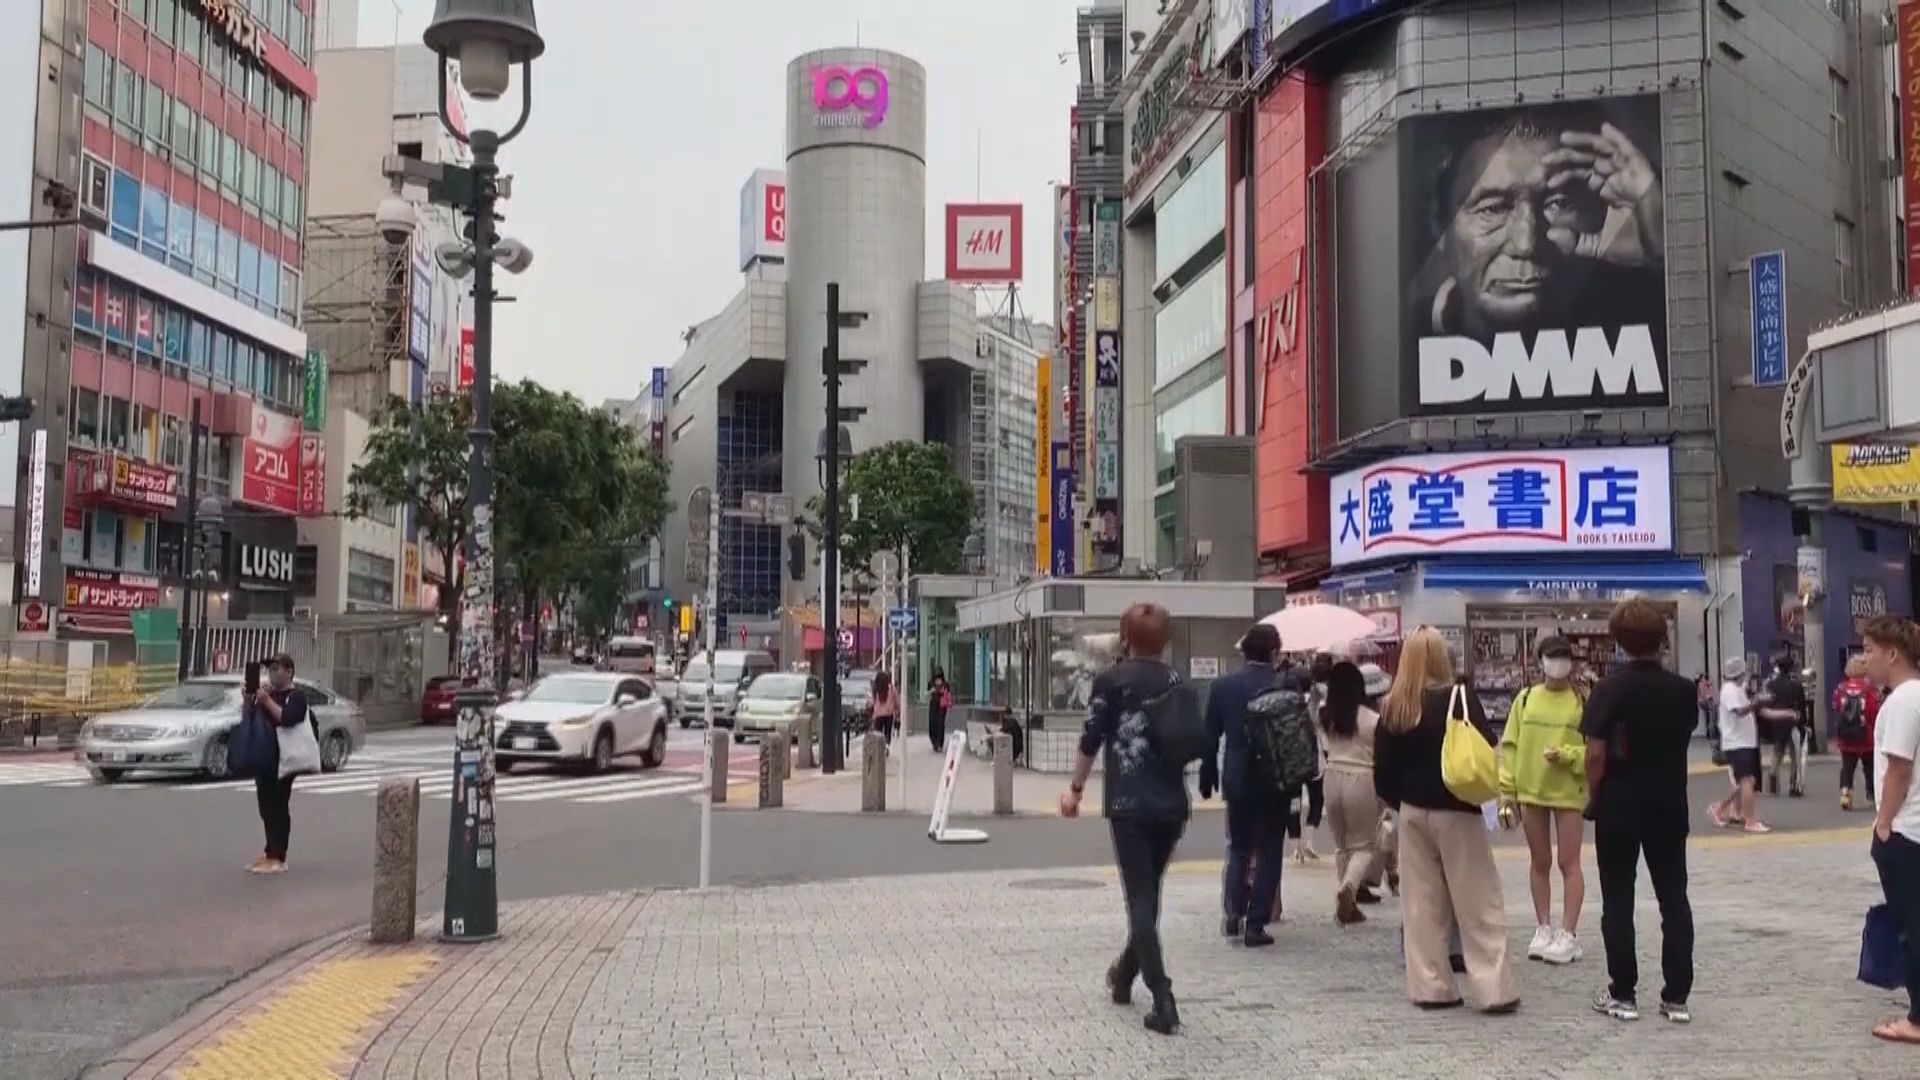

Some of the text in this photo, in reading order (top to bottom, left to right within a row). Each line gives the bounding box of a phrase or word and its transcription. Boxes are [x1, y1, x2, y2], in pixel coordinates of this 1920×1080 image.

[811, 65, 889, 131] 109
[813, 113, 861, 128] SHIBUYA
[965, 227, 1004, 256] H&M
[1418, 323, 1664, 406] DMM
[254, 446, 289, 480] アコム
[129, 471, 166, 491] サンドラッグ
[1339, 466, 1639, 544] 大盛堂書店
[1576, 532, 1656, 545] BOOKS TAISEIDO
[241, 545, 294, 581] LUSH
[90, 587, 144, 608] サンドラッグ
[1527, 580, 1599, 591] TAISEIDO
[1851, 594, 1872, 617] BOSS
